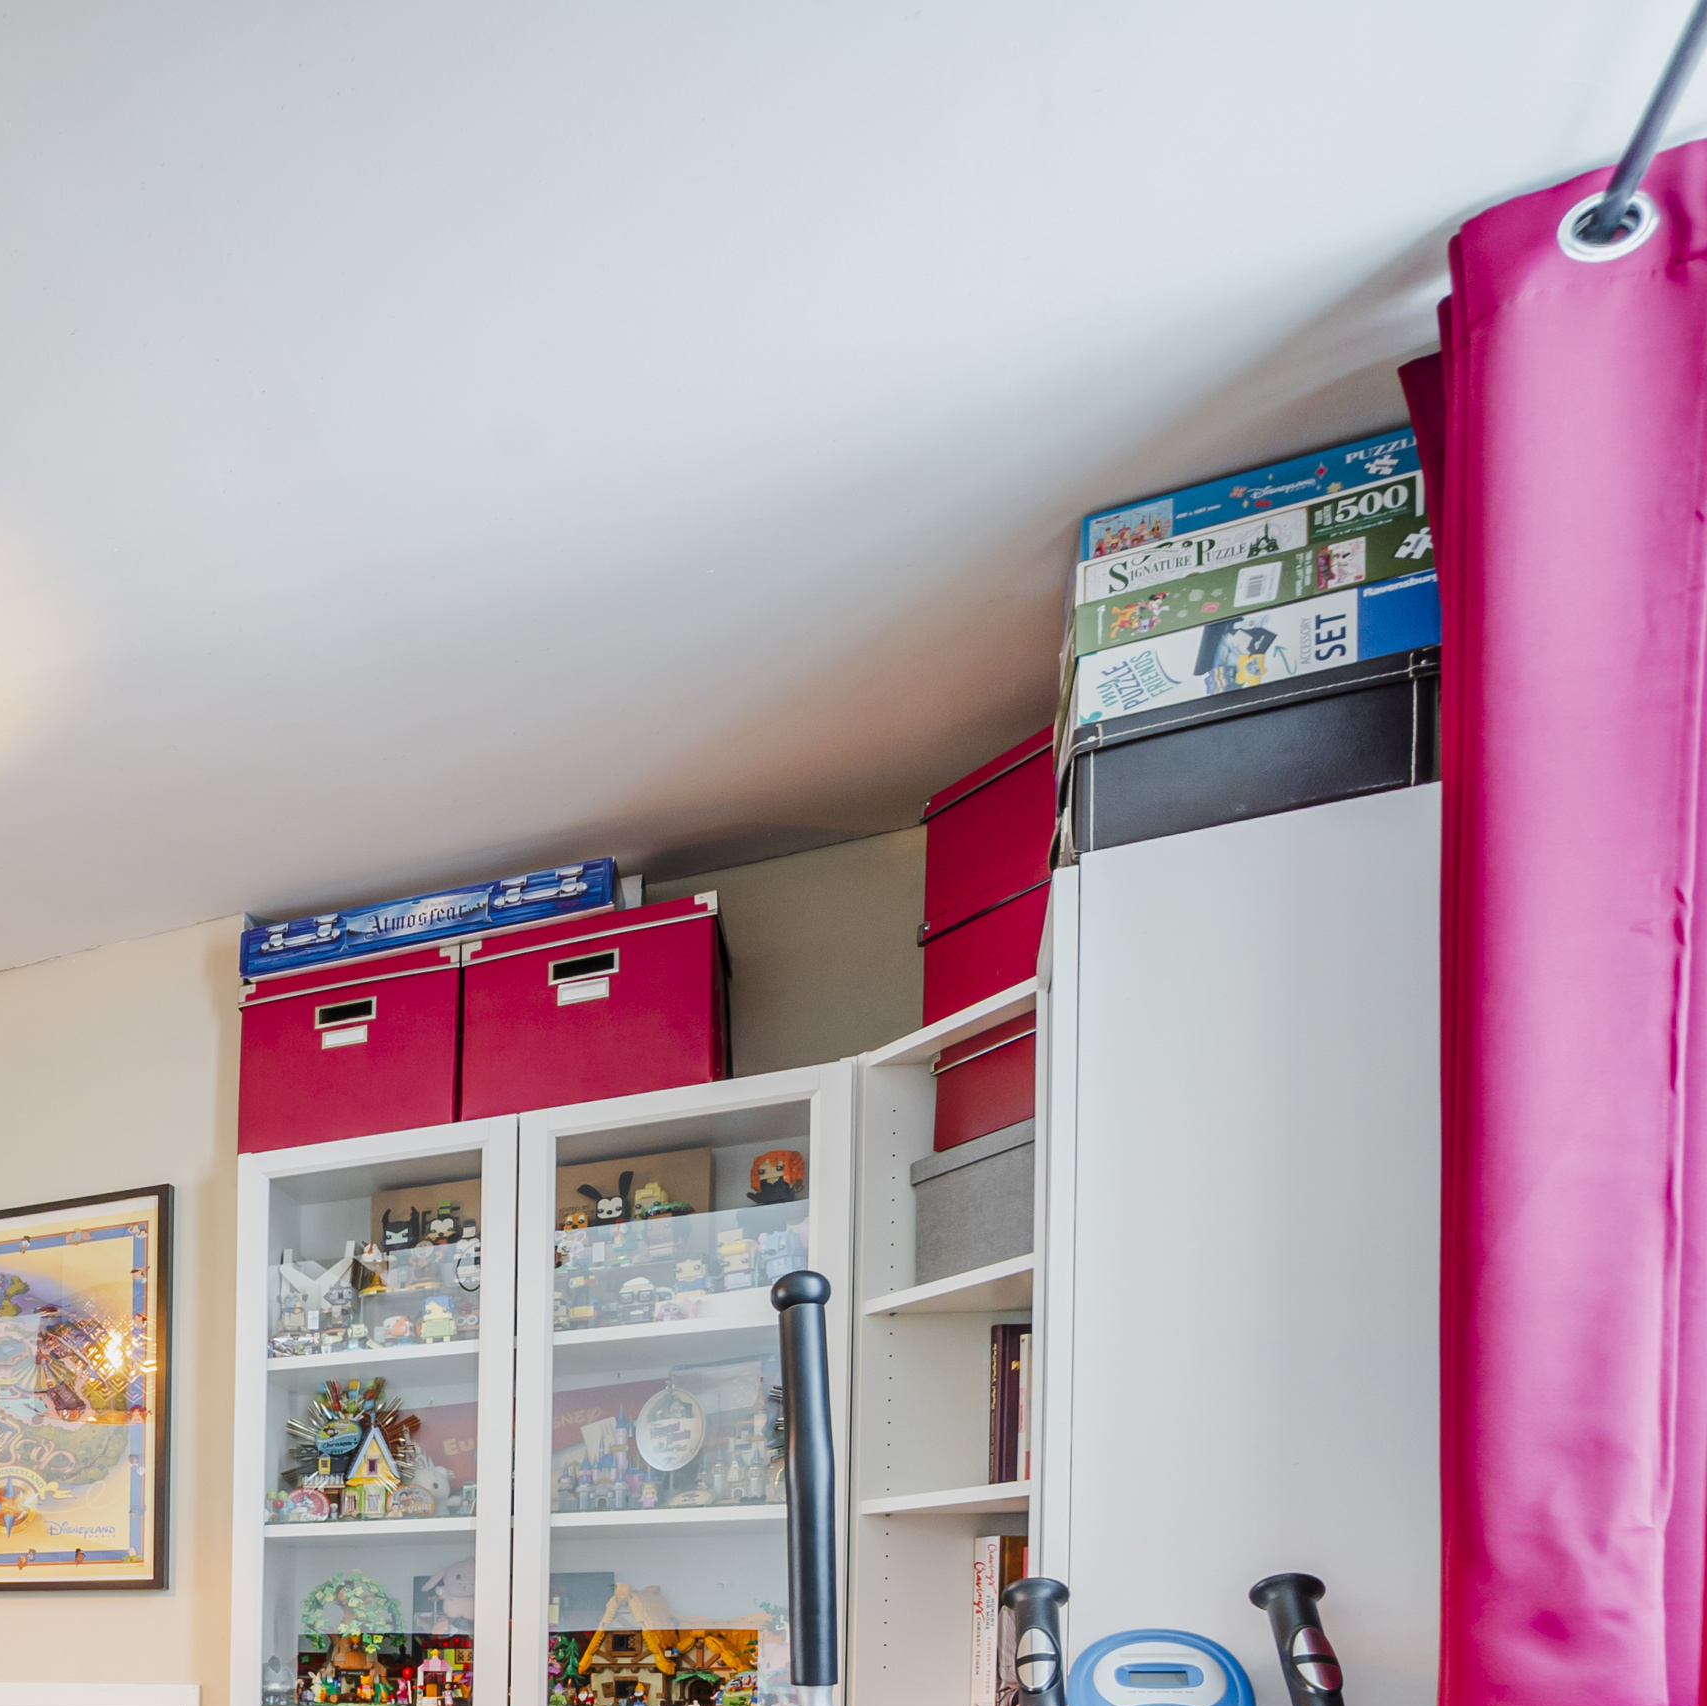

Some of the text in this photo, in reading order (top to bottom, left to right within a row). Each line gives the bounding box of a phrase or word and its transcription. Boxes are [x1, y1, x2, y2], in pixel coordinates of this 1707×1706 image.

[1344, 437, 1418, 465] PUZZL
[1335, 485, 1408, 523] 500
[1300, 618, 1312, 665] ACCESSORY
[1314, 613, 1347, 662] SET
[1101, 661, 1149, 711] PUZZLE
[1129, 650, 1174, 698] FRIENDS
[365, 903, 467, 941] Atmosfear
[973, 1561, 986, 1622] Cravings
